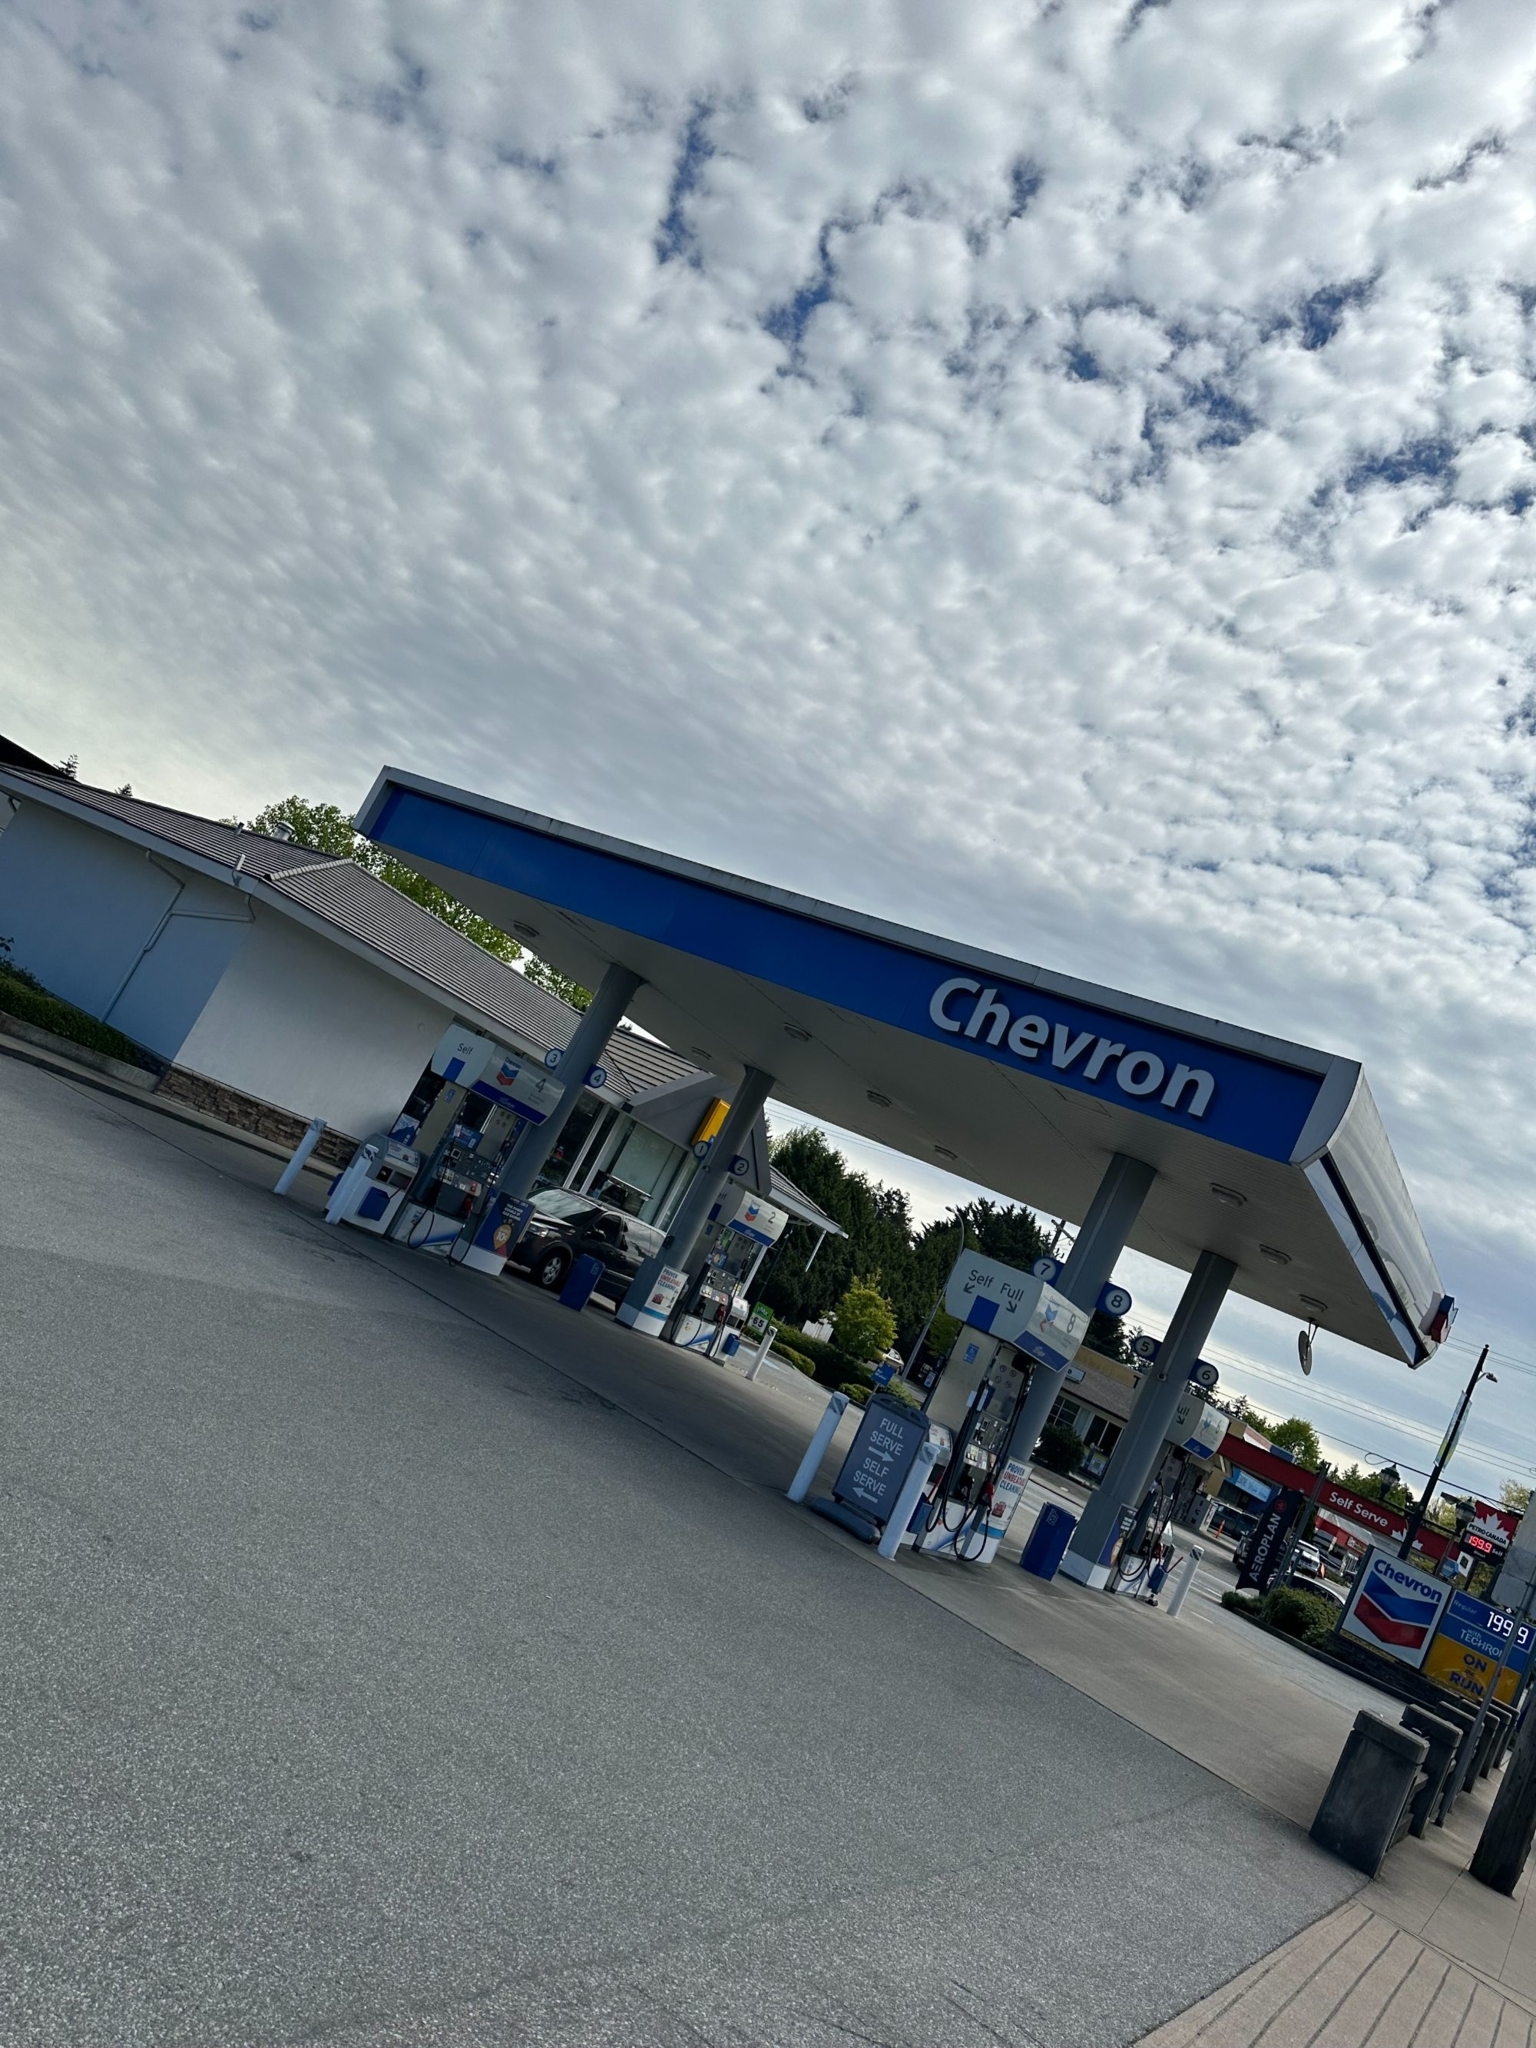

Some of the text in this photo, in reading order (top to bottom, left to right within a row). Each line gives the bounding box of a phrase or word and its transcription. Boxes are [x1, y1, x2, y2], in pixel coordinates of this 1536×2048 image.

[457, 1042, 474, 1056] Self
[929, 976, 1216, 1118] Chevron
[549, 1053, 558, 1063] 3
[535, 1078, 547, 1093] 4
[593, 1073, 602, 1084] 4
[736, 1162, 745, 1171] 2
[768, 1211, 776, 1224] 2
[1039, 1262, 1051, 1276] 7
[968, 1269, 1025, 1302] Self Full
[1111, 1294, 1123, 1308] 8
[1066, 1313, 1077, 1334] 8
[1140, 1341, 1150, 1352] 5
[1201, 1370, 1211, 1381] 6
[1176, 1404, 1190, 1417] ull
[879, 1417, 904, 1440] FULL
[870, 1430, 904, 1456] SERVE
[862, 1457, 890, 1478] SELF
[1006, 1462, 1025, 1476] PROVEN
[853, 1470, 886, 1497] SERVE
[1329, 1491, 1389, 1528] Self Serve
[1248, 1513, 1282, 1583] AEROPLAN
[1468, 1535, 1504, 1557] 199.9 Self
[1374, 1558, 1443, 1603] Chevron
[1453, 1599, 1478, 1615] Regular
[1467, 1628, 1482, 1639] with
[1463, 1653, 1487, 1673] ON
[1450, 1671, 1484, 1696] RUN
